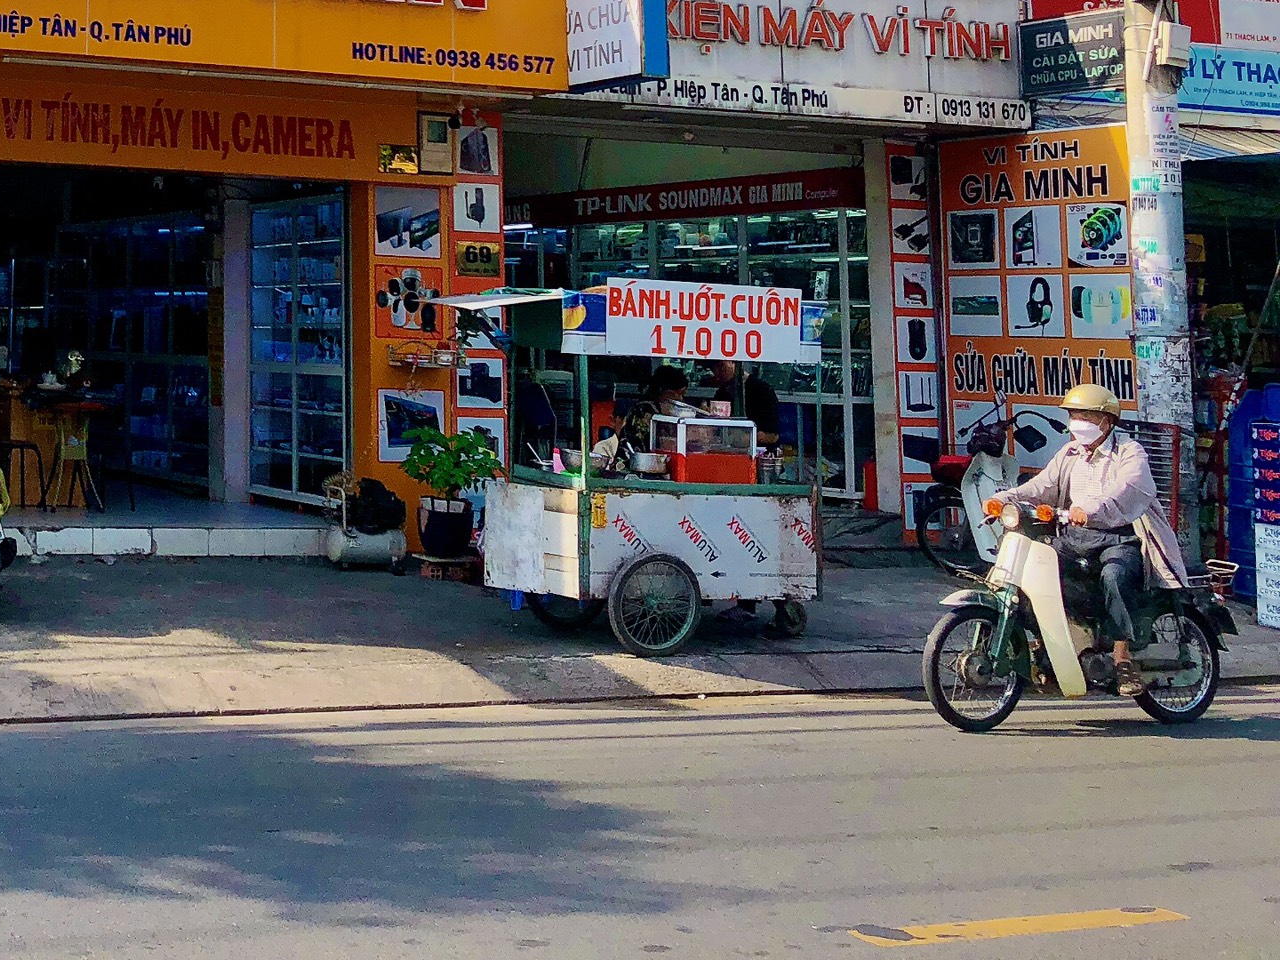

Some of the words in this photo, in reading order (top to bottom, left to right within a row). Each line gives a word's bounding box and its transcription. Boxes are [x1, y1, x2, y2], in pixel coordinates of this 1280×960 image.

[39, 13, 77, 37] TÂN
[154, 23, 192, 46] PHÚ
[914, 7, 1011, 61] TÍNH
[1035, 31, 1065, 48] GIA
[1068, 23, 1114, 44] MINH
[352, 41, 432, 67] HOTLINE:
[435, 48, 480, 69] 0938
[485, 51, 519, 72] 456
[522, 54, 556, 74] 577
[583, 40, 623, 68] TÍNH
[1058, 69, 1077, 81] CPU
[1084, 63, 1124, 78] LAPTOP
[1232, 60, 1280, 90] THẠ
[674, 79, 707, 105] Hiệp
[710, 82, 739, 102] Tân
[802, 87, 828, 109] Phú
[941, 99, 971, 118] 0913
[975, 101, 997, 119] 131
[1001, 102, 1026, 122] 670
[2, 96, 33, 140] VI
[983, 146, 1008, 166] VI
[1015, 137, 1080, 163] TÍNH
[574, 193, 654, 216] TP-LINK
[658, 185, 743, 211] SOUNDMAX
[748, 185, 768, 204] GIA
[772, 182, 803, 202] MINH
[959, 172, 1015, 204] GIA
[1024, 164, 1110, 202] MINH
[465, 245, 491, 263] 69
[650, 324, 762, 359] 17.000
[953, 341, 988, 395] SỬA
[991, 348, 1039, 396] CHỮA
[1042, 348, 1083, 396] MÁY
[1087, 349, 1135, 402] TÍNH
[678, 515, 719, 563] ALUMAX
[726, 515, 768, 563] ALUMAX
